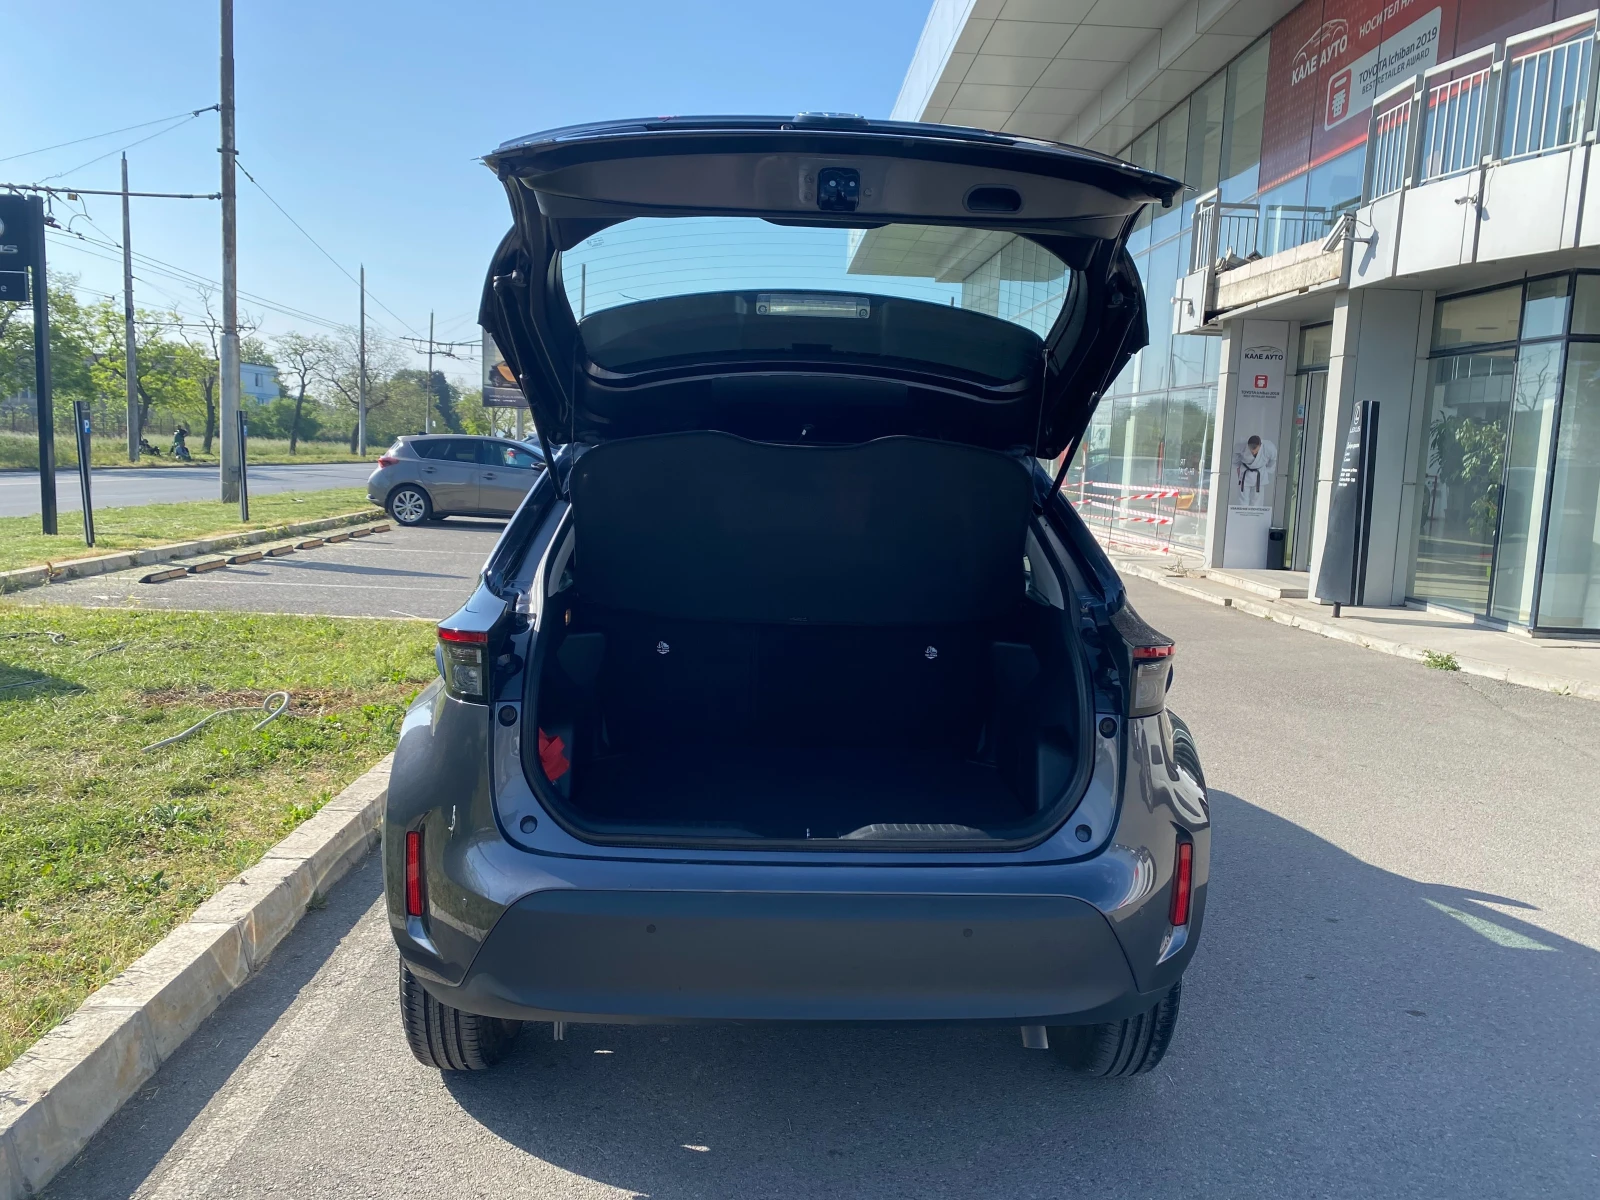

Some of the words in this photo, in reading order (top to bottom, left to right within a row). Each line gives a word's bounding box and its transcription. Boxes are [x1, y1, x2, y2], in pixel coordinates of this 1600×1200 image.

[1359, 0, 1399, 39] НОСИТЕЛ
[1291, 54, 1317, 86] КАЛЕ
[1319, 35, 1348, 68] АУТО
[1358, 60, 1387, 84] TOYOTA
[1388, 43, 1415, 68] Ichiban
[1415, 26, 1438, 49] 2019
[1361, 80, 1376, 95] BEST
[1377, 63, 1405, 87] RETAILER
[1406, 47, 1430, 68] AWARD
[1264, 353, 1284, 361] АУТО
